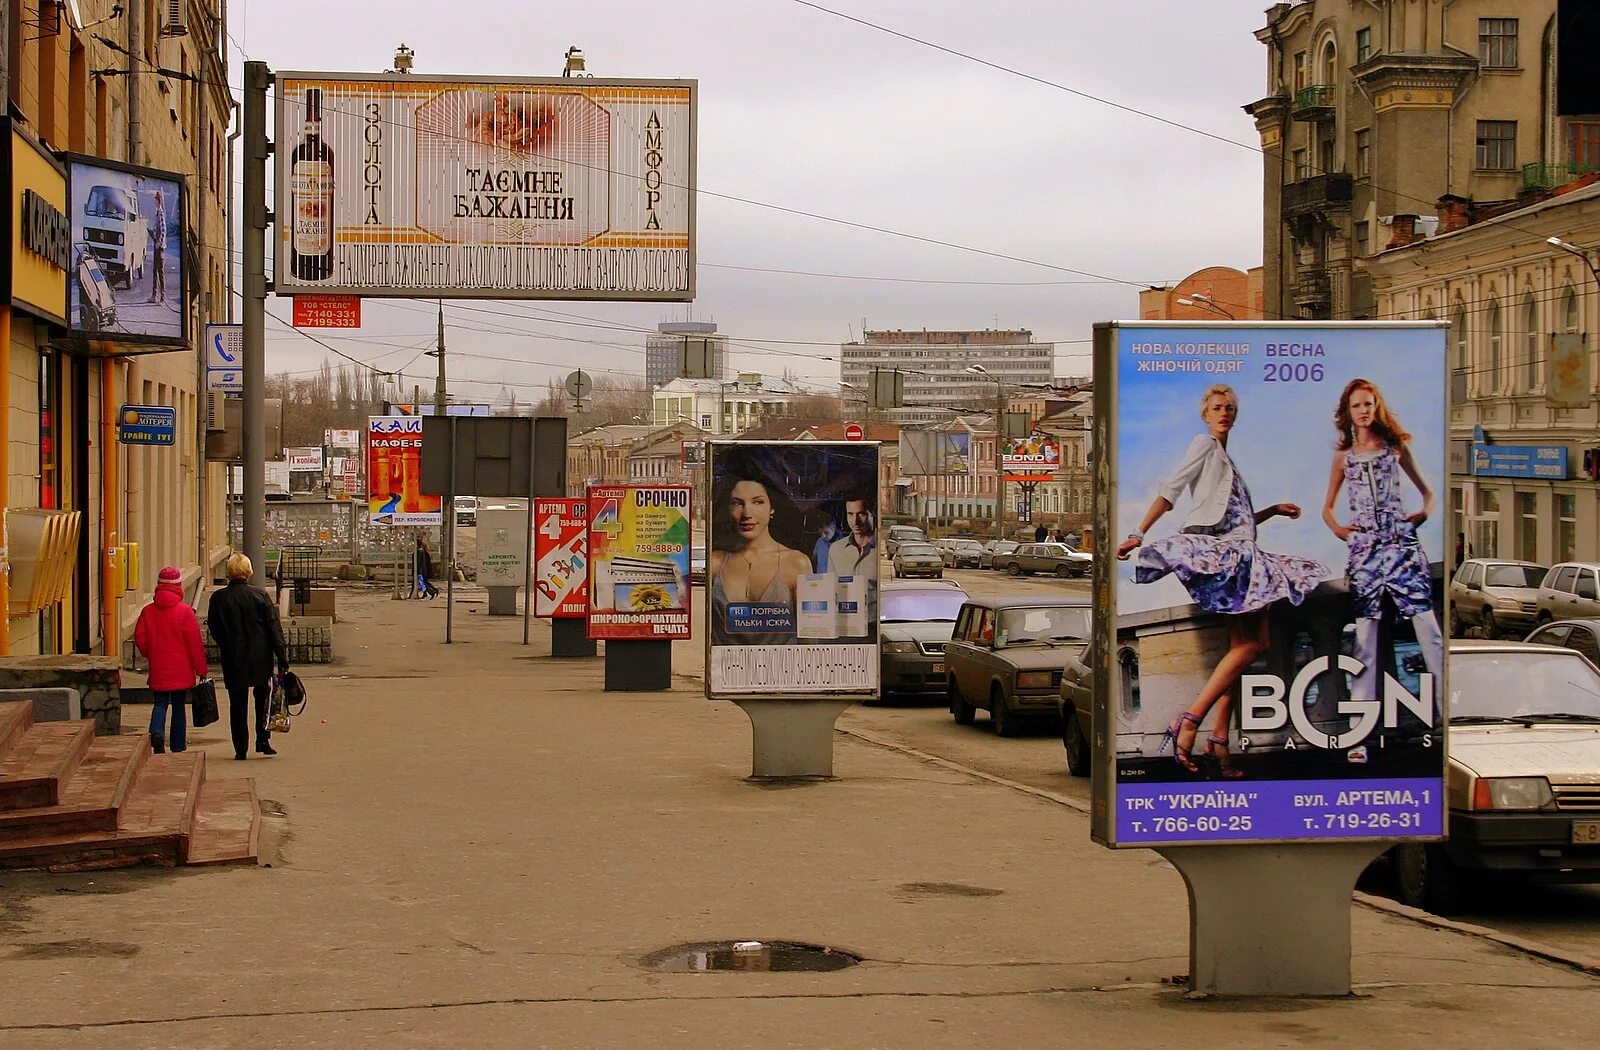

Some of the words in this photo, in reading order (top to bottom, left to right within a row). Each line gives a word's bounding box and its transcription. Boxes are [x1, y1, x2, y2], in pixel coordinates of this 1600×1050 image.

[644, 109, 663, 231] АМФОРА
[465, 168, 563, 194] ТАЄМНЕ
[453, 195, 574, 220] БАЖАННЯ
[1132, 343, 1172, 355] НОВА
[1176, 343, 1250, 357] КОЛЕКЦІЯ
[1265, 343, 1326, 357] ВЕСНА
[1137, 359, 1201, 373] ЖІНОЧІЙ
[1204, 360, 1244, 375] ОДЯГ
[1263, 363, 1324, 382] 2006
[635, 490, 687, 507] СРОЧНО
[539, 503, 567, 514] АРТЕМА
[539, 514, 562, 540] 4
[591, 498, 623, 540] 4
[635, 544, 682, 553] 759-888-0
[590, 614, 689, 624] ШИРОКОФОРМАТНАЯ
[751, 607, 791, 615] ПОТРІБНА
[653, 624, 689, 634] ПЕЧАТЬ
[1241, 655, 1434, 749] BGN
[1125, 797, 1154, 811] ТРК
[1158, 790, 1258, 809] "УКРАЇНА"
[1294, 795, 1329, 807] ВУЛ.
[1152, 815, 1252, 832] 766-60-25
[1323, 812, 1421, 829] 719-26-31
